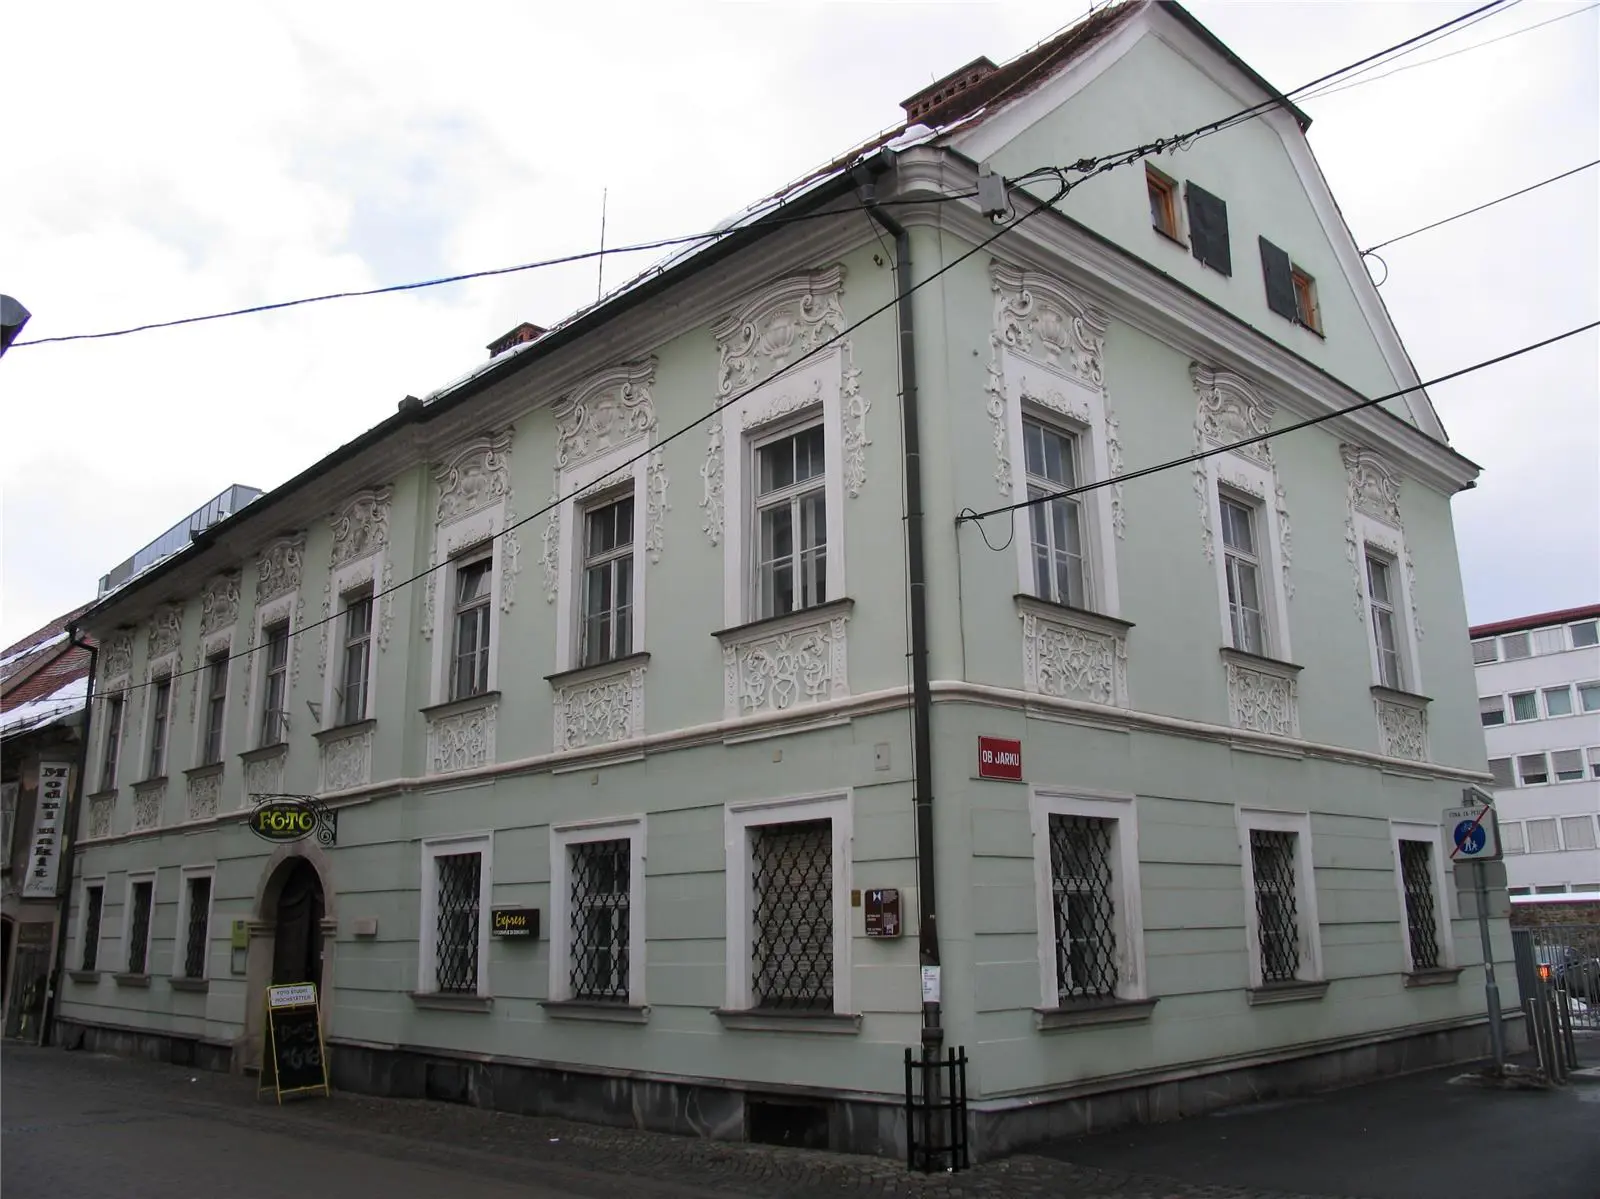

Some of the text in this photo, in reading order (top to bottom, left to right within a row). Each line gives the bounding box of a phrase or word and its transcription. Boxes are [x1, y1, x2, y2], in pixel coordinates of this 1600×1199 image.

[982, 750, 1020, 767] OB JARKU
[260, 811, 313, 830] FOTO
[495, 911, 527, 930] Express
